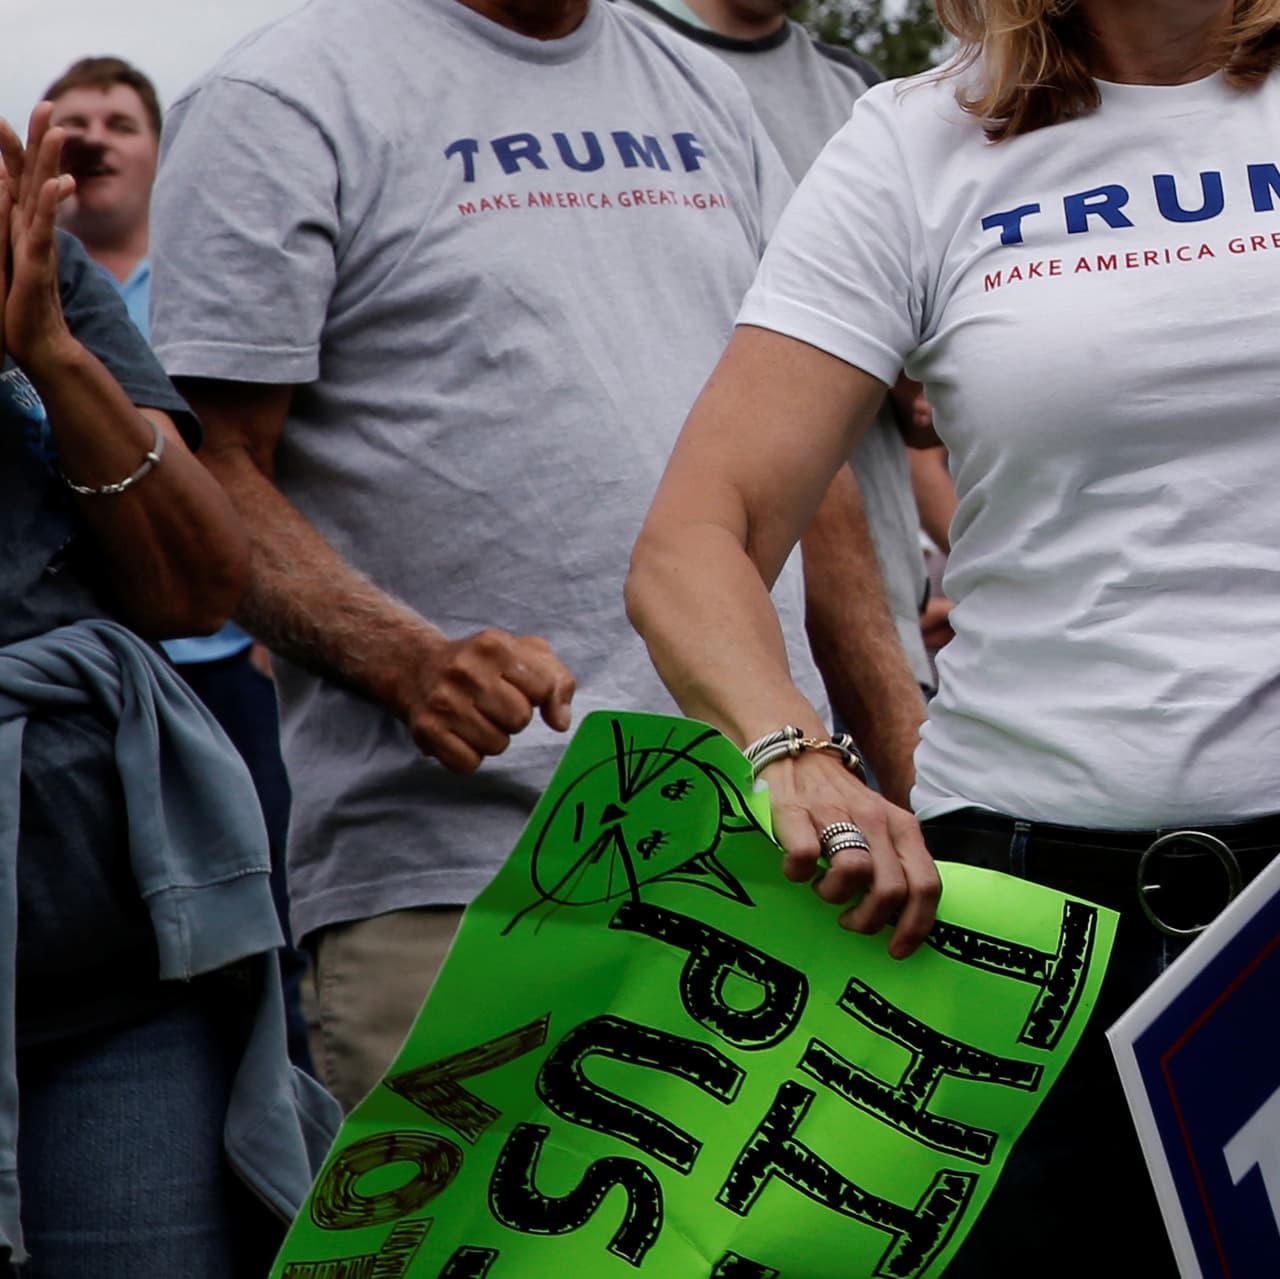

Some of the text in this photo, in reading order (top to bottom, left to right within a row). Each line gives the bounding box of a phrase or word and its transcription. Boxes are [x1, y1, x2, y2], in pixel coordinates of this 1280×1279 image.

[458, 189, 733, 217] MAKE AMERICA GREAT AGAI
[983, 258, 1064, 293] MAKE
[1073, 243, 1216, 274] AMERICA
[435, 900, 810, 1279] PUS
[709, 898, 1098, 1279] THI
